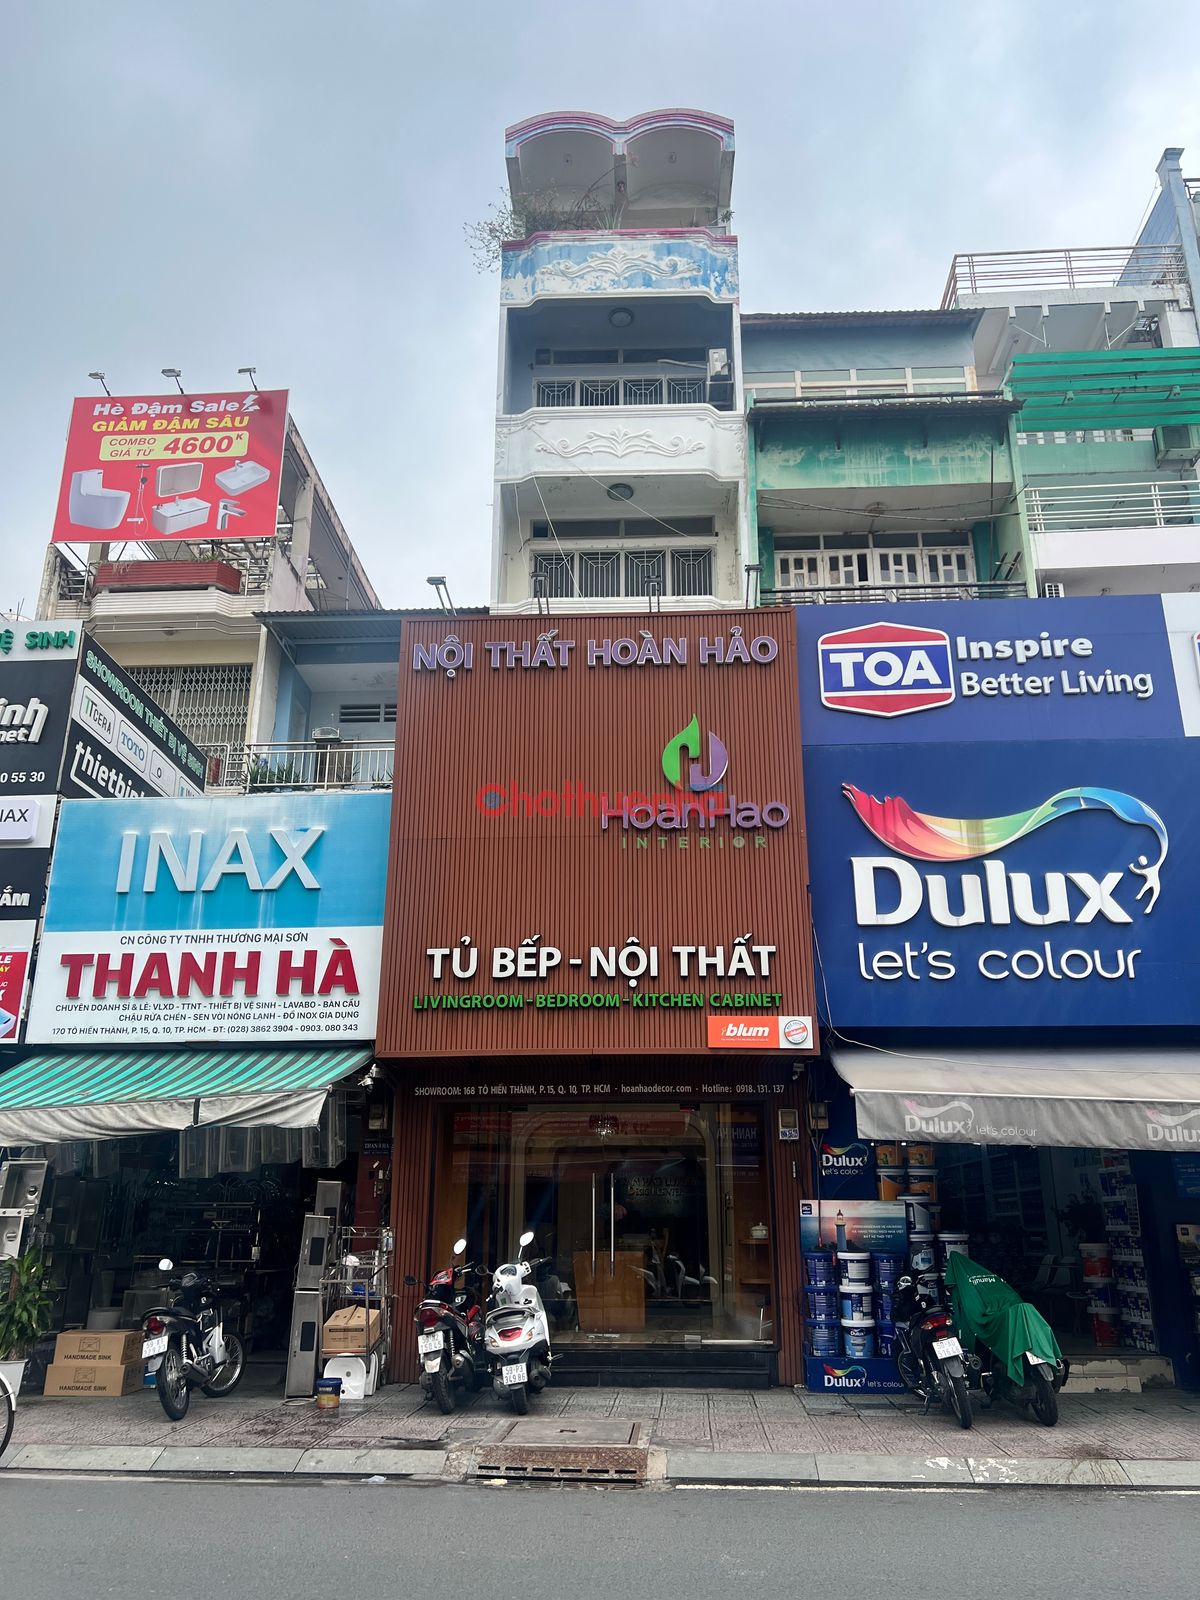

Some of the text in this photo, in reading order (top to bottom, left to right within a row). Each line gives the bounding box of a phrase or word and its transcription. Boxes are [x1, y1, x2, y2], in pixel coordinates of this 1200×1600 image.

[92, 399, 241, 416] Hè Đậm Sale
[92, 414, 250, 432] GIẢM ĐẬM SÂU
[109, 437, 156, 446] COMBO
[110, 448, 131, 457] GIÁ
[25, 630, 76, 650] SINH
[956, 632, 1093, 664] Inspire
[412, 626, 779, 679] NỘI THẤT HOÀN HẢO
[830, 650, 942, 687] TOA
[86, 650, 144, 718] SHOWROOM
[960, 669, 1154, 699] Better Living
[121, 731, 145, 762] TOTO
[11, 772, 26, 782] 55
[30, 772, 45, 782] 30
[601, 795, 790, 830] HoanHao
[622, 836, 767, 849] INTERIOR
[115, 827, 326, 893] INAX
[851, 856, 1134, 927] Dulux
[120, 933, 308, 945] CN CÔNG TY TNHH THƯƠNG MẠI SƠN
[60, 951, 262, 999] THANH
[275, 938, 360, 996] HÀ
[426, 935, 478, 979] TỦ
[492, 934, 562, 978] BẾP
[590, 936, 658, 988] NỘI
[672, 933, 777, 977] THẤT
[858, 941, 1142, 980] let's colour
[55, 1003, 89, 1012] CHUYÊN
[209, 1001, 233, 1010] THIẾT
[244, 1001, 254, 1011] VỆ
[323, 1000, 341, 1008] BÀN
[342, 999, 360, 1008] CẦU
[413, 994, 524, 1010] LIVINGROOM
[535, 994, 620, 1008] BEDROOM
[632, 993, 704, 1008] KITCHEN
[710, 993, 783, 1008] CABINET
[119, 1013, 142, 1022] CHẬU
[144, 1013, 161, 1021] RỬA
[163, 1013, 186, 1021] CHÉN
[212, 1012, 225, 1020] VÒI
[227, 1012, 251, 1020] NÓNG
[253, 1012, 276, 1021] LẠNH
[283, 1010, 295, 1019] ĐỒ
[335, 1012, 359, 1020] DỤNG
[67, 1026, 78, 1034] TÔ
[79, 1025, 98, 1034] HIẾN
[100, 1026, 129, 1035] THÀNH,
[140, 1027, 150, 1035] 15,
[228, 1025, 249, 1033] (028)
[726, 1024, 770, 1037] blum
[414, 1087, 461, 1096] SHOWROOM:
[478, 1085, 489, 1094] TÔ
[491, 1084, 507, 1094] HIẾN
[510, 1084, 537, 1094] THÀNH,
[558, 1085, 566, 1093] Q.
[593, 1085, 610, 1093] HCM
[621, 1084, 692, 1093] hoanhaodecor.com
[702, 1084, 732, 1093] Hotline:
[905, 1114, 966, 1134] Dulux
[1001, 1125, 1037, 1137] colour
[822, 1154, 863, 1166] Dulux
[824, 1376, 861, 1387] Dulux
